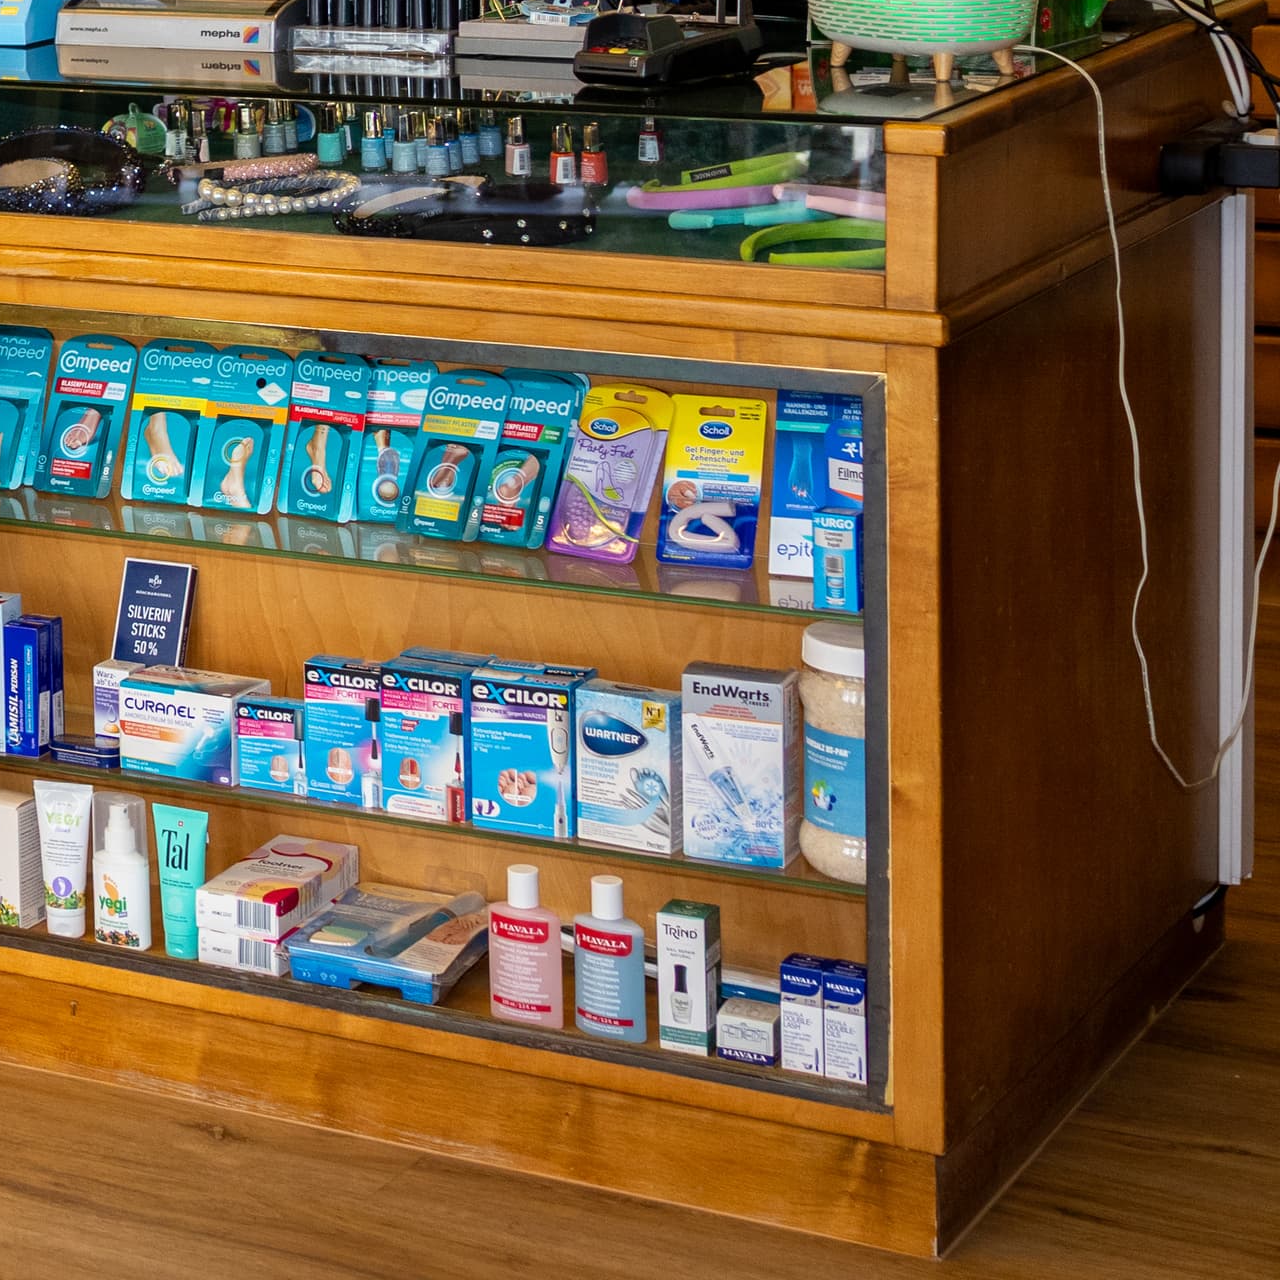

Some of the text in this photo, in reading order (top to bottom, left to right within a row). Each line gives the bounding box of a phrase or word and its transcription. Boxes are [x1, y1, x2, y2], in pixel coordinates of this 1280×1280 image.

[201, 29, 240, 40] mepha
[60, 350, 132, 373] Compeed
[144, 348, 213, 371] Compeed
[217, 355, 288, 378] Compeed
[298, 358, 362, 383] Compeed
[429, 386, 506, 412] Compeed
[591, 420, 617, 434] Scholl
[702, 424, 731, 437] Scholl
[577, 439, 635, 459] Party Feet
[700, 447, 728, 455] Finger-
[690, 454, 738, 464] Zehenschutz
[142, 484, 176, 496] Compeed
[820, 518, 854, 529] URGO
[128, 604, 172, 623] SILVERIN
[131, 623, 166, 639] STICKS
[134, 641, 158, 656] 50 %
[96, 670, 116, 679] Warz-
[306, 669, 376, 692] eXCILOR
[383, 673, 457, 696] eXCILOR
[692, 681, 769, 702] EndWarts
[124, 697, 195, 719] CURANEL
[432, 700, 458, 710] FORTE
[239, 705, 294, 723] eXCILOR
[586, 726, 640, 744] WARTNER
[691, 723, 715, 759] EndWarts
[162, 829, 190, 871] Tal
[98, 898, 127, 914] yegi
[499, 922, 544, 936] MAVALA
[663, 923, 698, 940] TRIND
[582, 933, 627, 950] MAVALA
[783, 974, 818, 986] MAVALA
[826, 982, 861, 994] MAVALA
[721, 1049, 767, 1063] MAVALA
